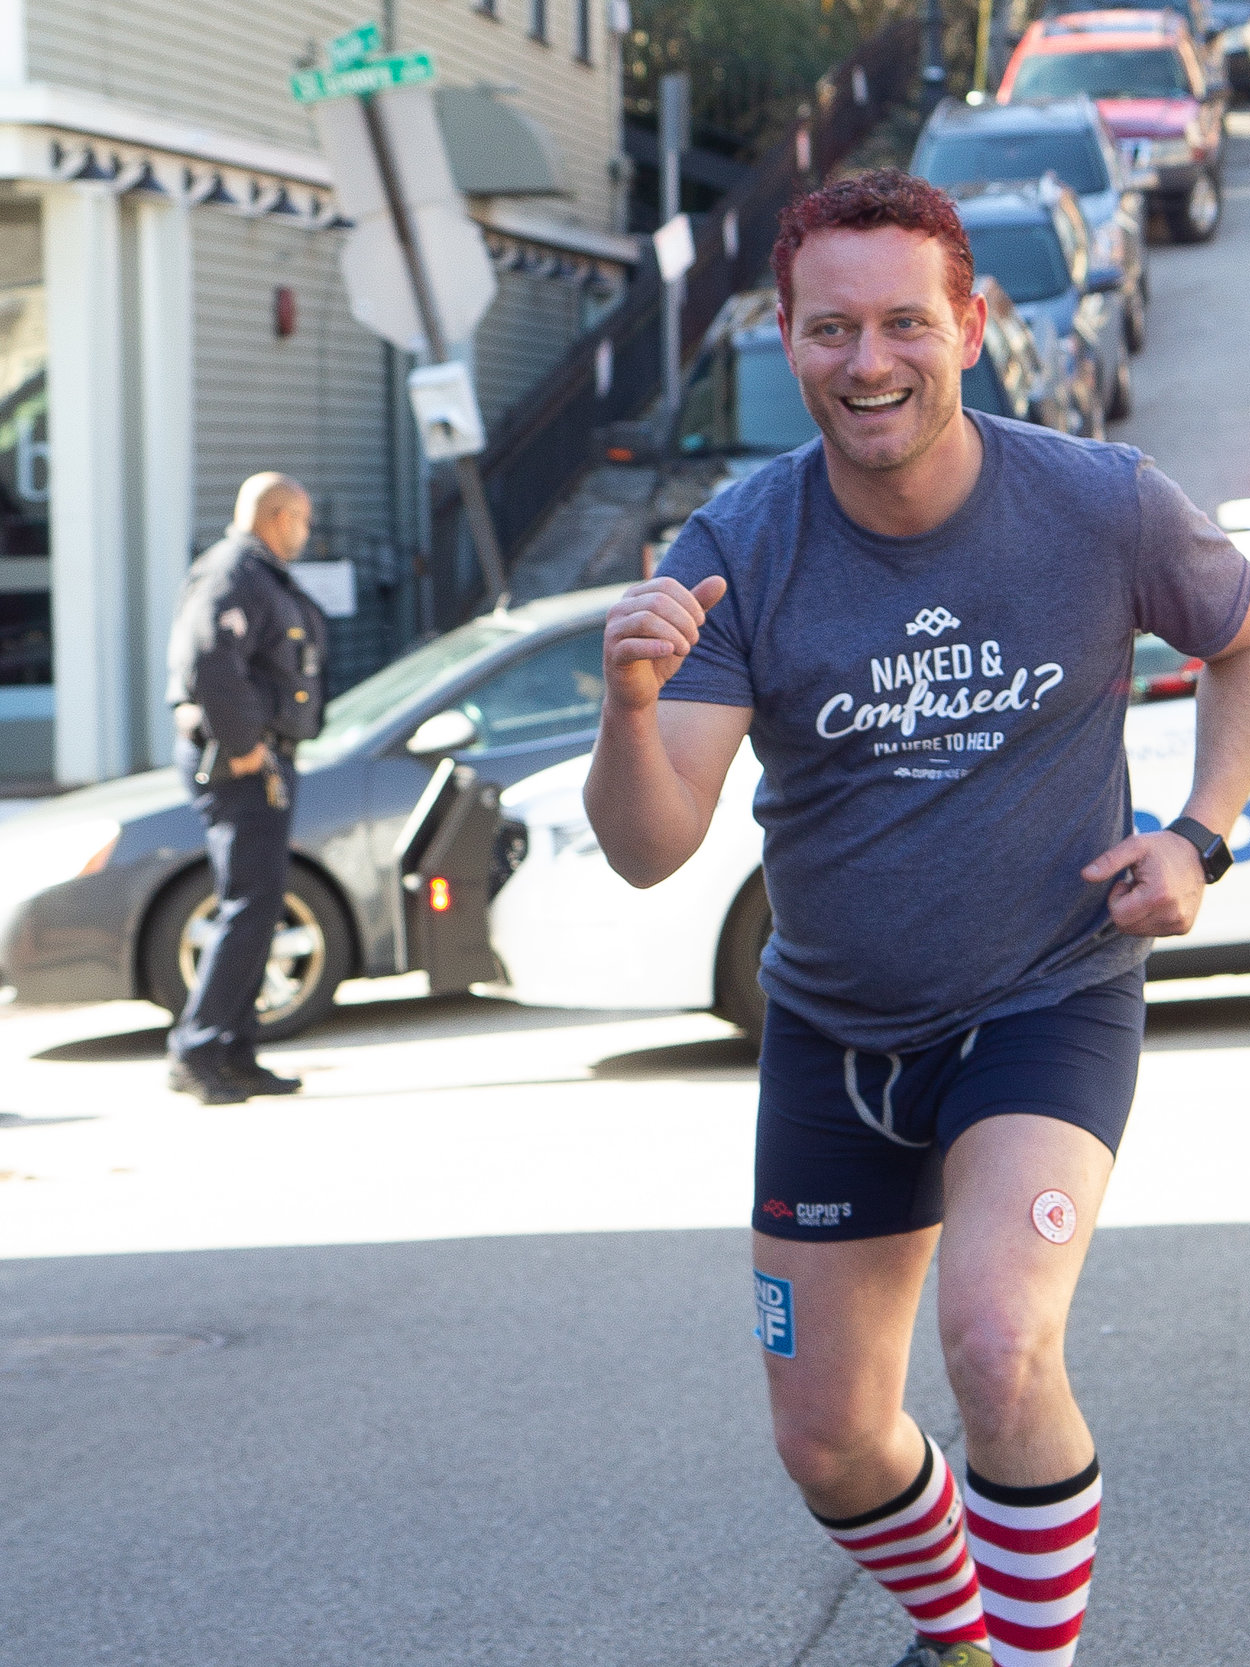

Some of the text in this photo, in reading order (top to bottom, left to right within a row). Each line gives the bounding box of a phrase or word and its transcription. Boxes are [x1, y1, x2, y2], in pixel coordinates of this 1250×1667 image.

[870, 639, 1005, 693] NAKED &
[816, 662, 1064, 739] Confused?
[873, 742, 899, 756] I'M
[943, 732, 965, 752] TO
[966, 731, 1005, 751] HELP
[796, 1202, 852, 1218] CUPID'S
[754, 1278, 784, 1307] ND
